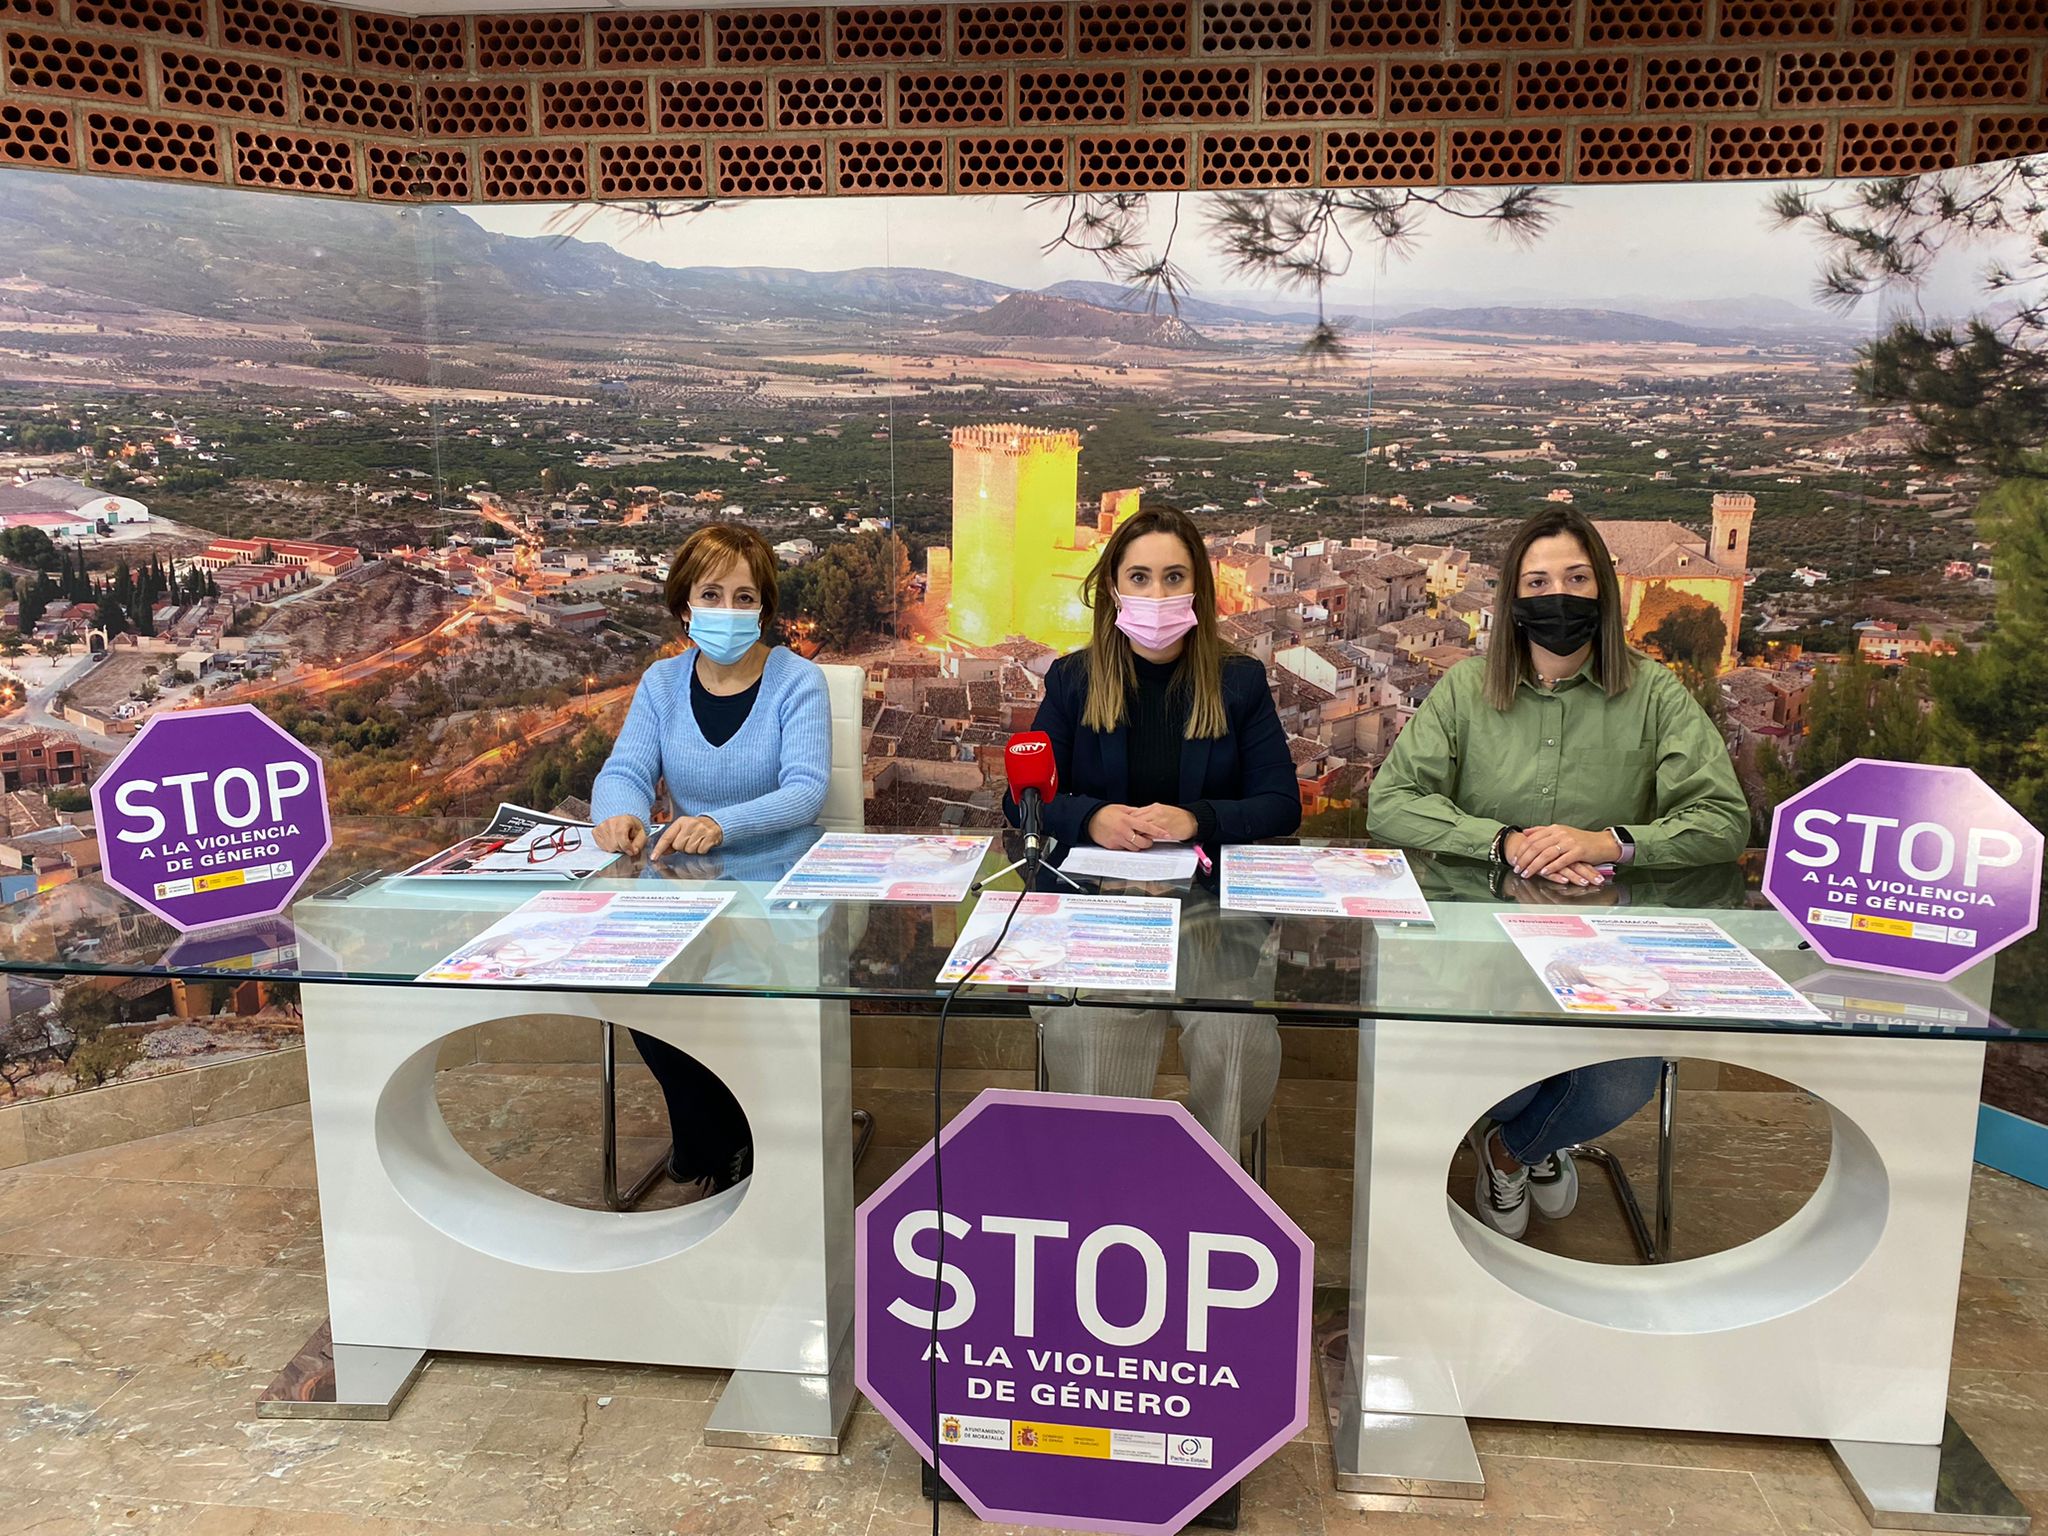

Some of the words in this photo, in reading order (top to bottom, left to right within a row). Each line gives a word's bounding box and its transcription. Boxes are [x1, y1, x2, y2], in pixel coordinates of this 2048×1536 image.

[115, 761, 309, 843] STOP
[140, 848, 155, 860] A
[162, 842, 190, 856] LA
[195, 824, 300, 850] VIOLENCIA
[167, 858, 193, 872] DE
[200, 844, 280, 867] GÉNERO
[1785, 809, 2022, 887] STOP
[1802, 872, 1820, 884] A
[1828, 874, 1858, 888] LA
[1866, 880, 1996, 906] VIOLENCIA
[1828, 891, 1858, 905] DE
[1866, 896, 1964, 920] GÉNERO
[887, 1210, 1279, 1352] STOP
[922, 1342, 950, 1363] A
[964, 1344, 1013, 1369] LA
[1027, 1349, 1240, 1389] VIOLENCIA
[968, 1378, 1015, 1402] DE
[1031, 1382, 1192, 1418] GÉNERO
[964, 1427, 1005, 1435] AYUNTAMIENTO
